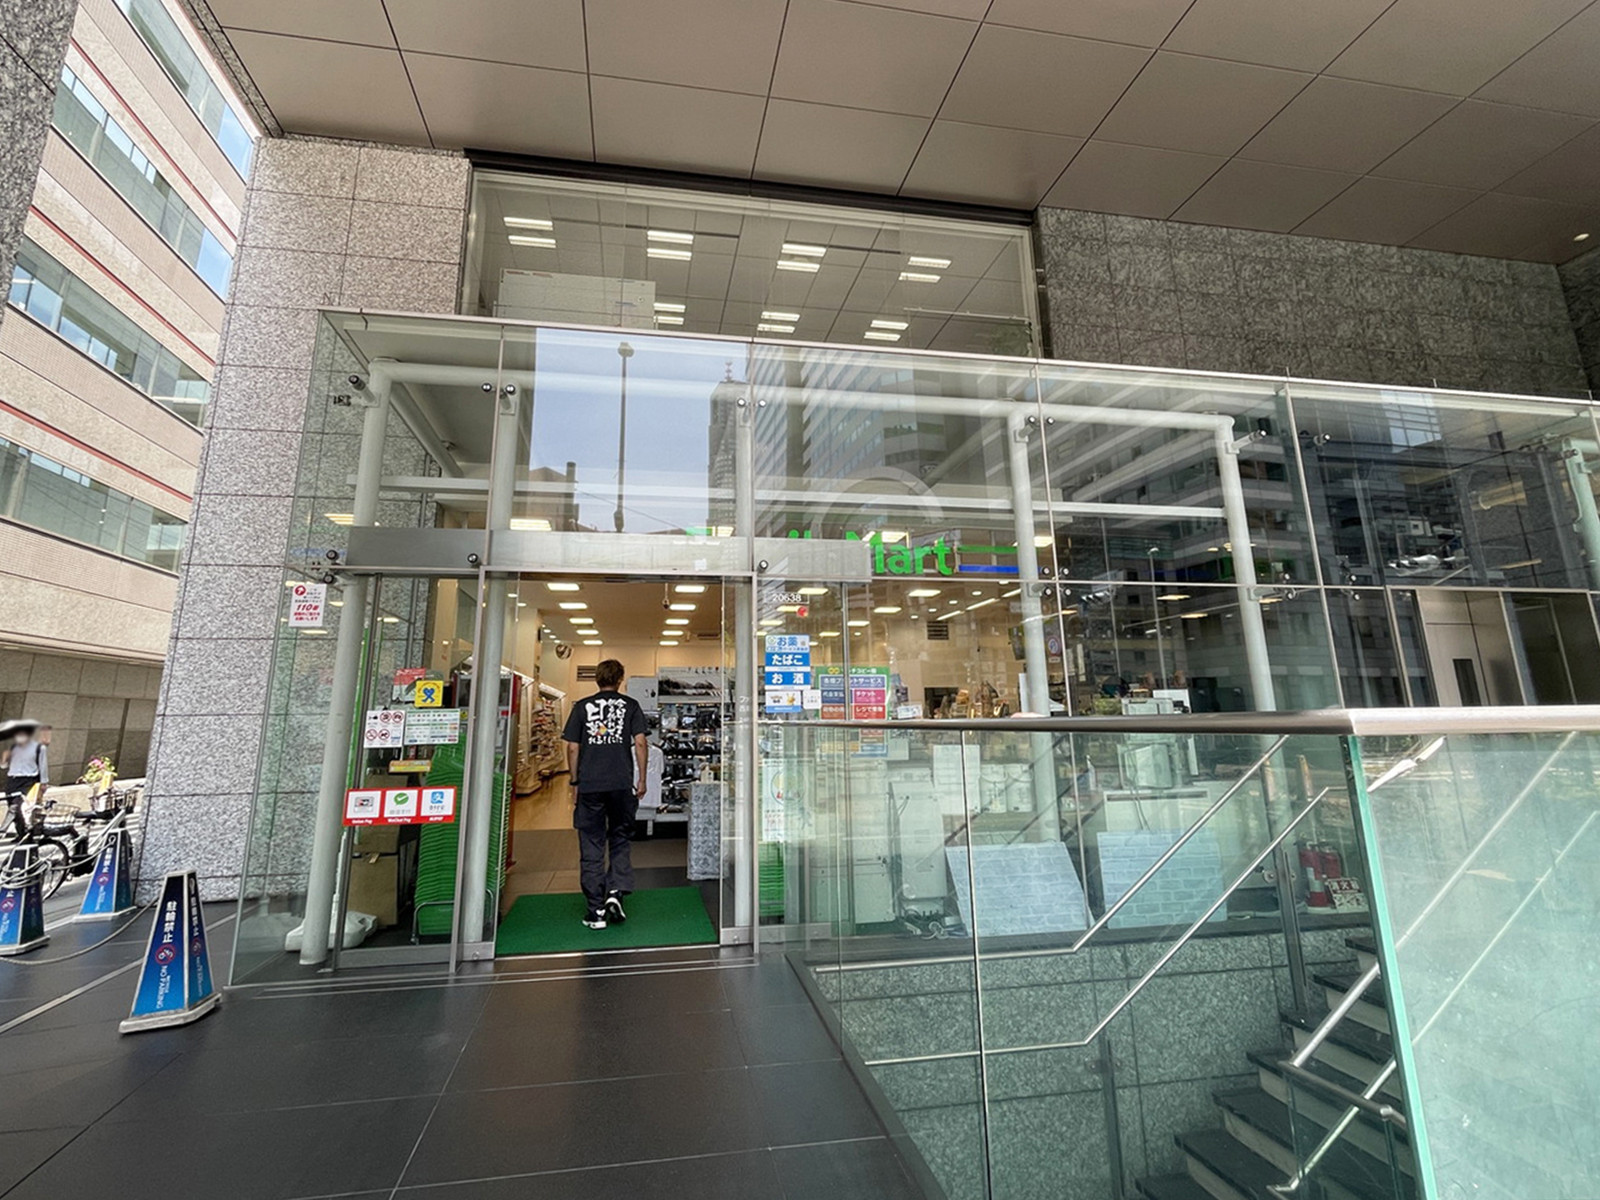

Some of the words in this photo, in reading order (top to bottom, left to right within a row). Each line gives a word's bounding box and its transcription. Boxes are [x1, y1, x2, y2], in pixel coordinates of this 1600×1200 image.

[772, 653, 803, 666] たばこ
[162, 900, 178, 943] 駐輪禁止
